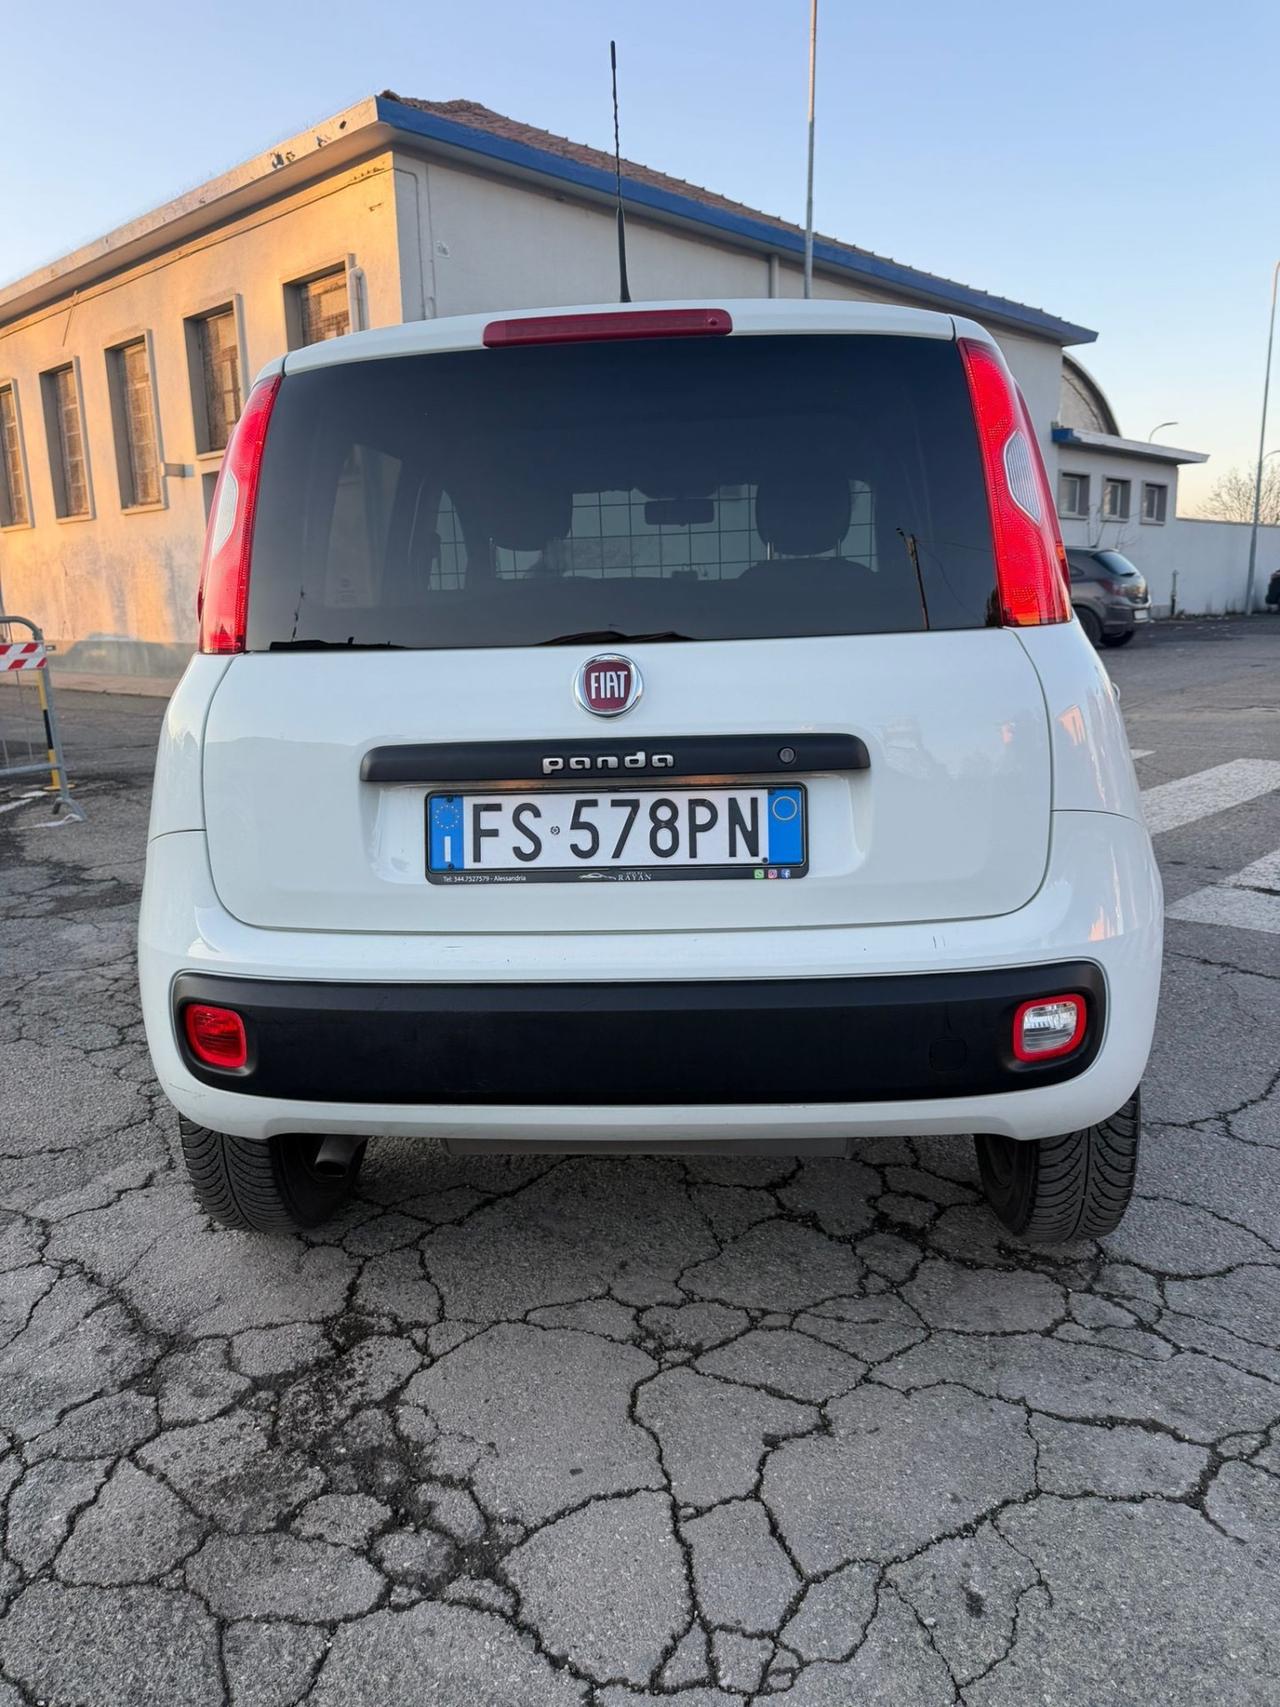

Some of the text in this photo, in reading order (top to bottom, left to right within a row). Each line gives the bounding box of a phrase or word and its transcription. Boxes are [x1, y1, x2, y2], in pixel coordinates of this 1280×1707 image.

[590, 671, 628, 699] FIAT
[542, 751, 674, 774] panda
[472, 797, 760, 862] FS 578PN
[444, 836, 452, 862] I
